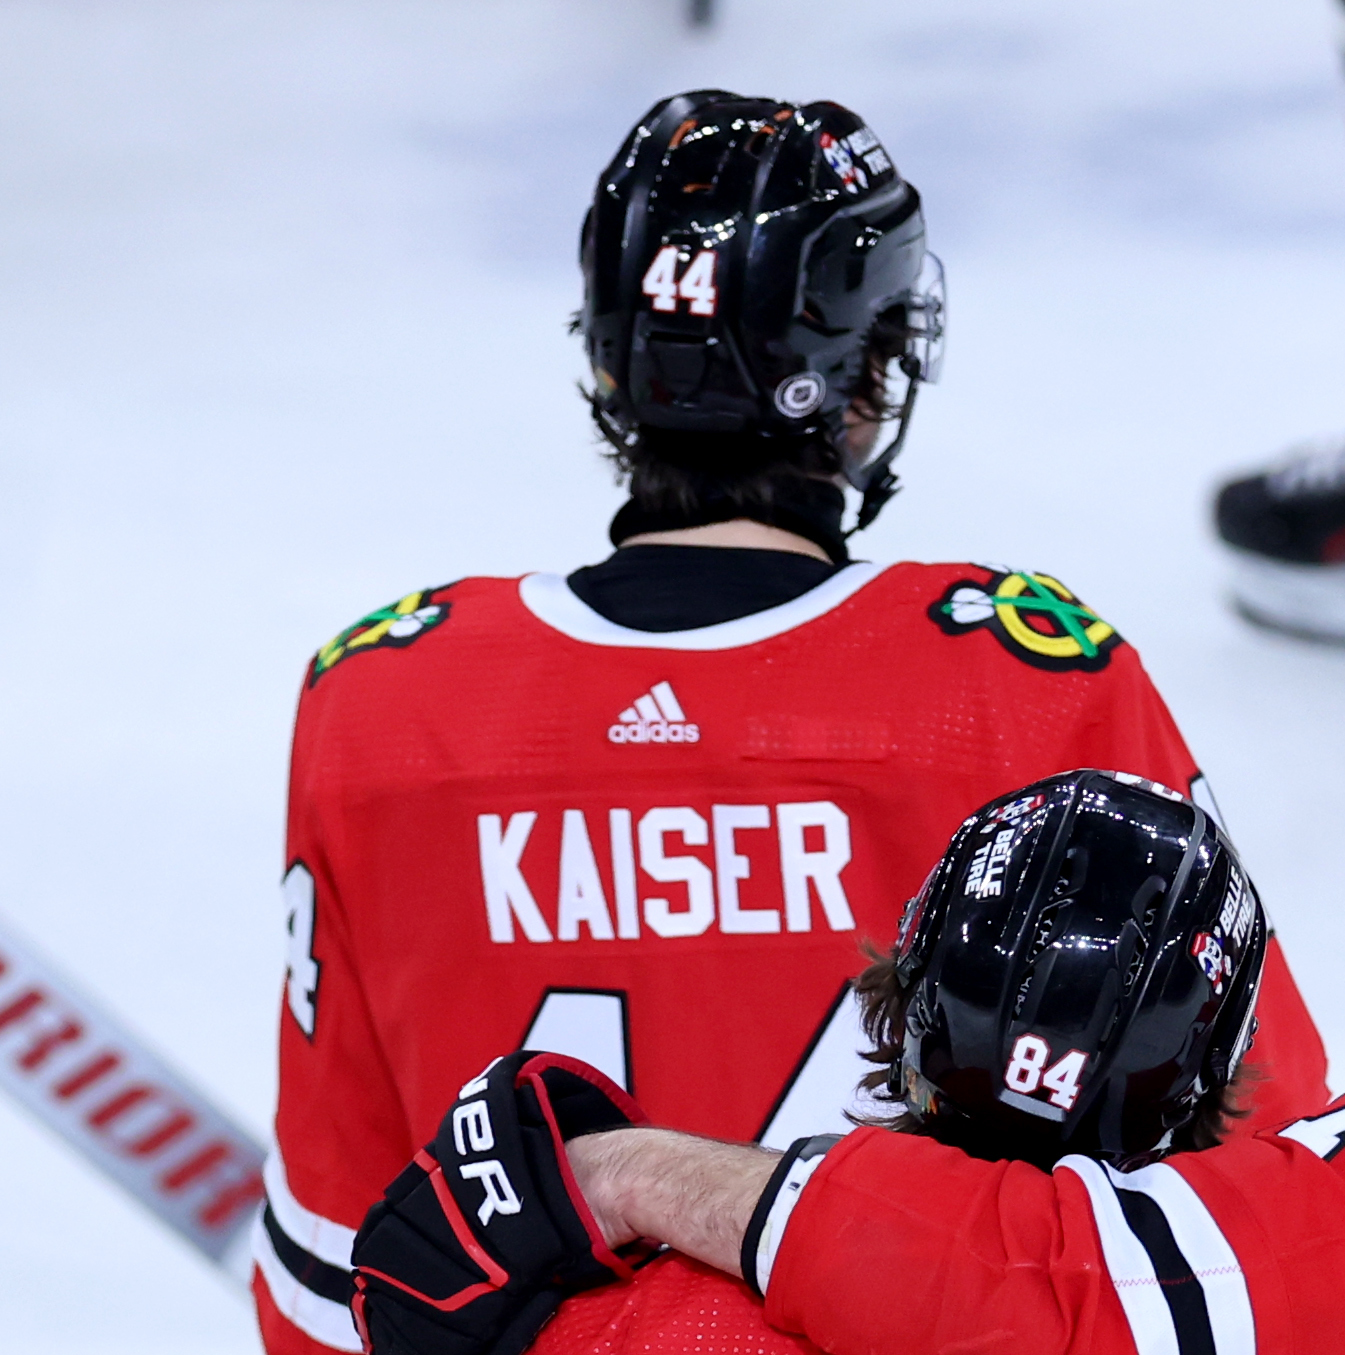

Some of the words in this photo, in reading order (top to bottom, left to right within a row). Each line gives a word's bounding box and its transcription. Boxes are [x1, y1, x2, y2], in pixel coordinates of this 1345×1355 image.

[643, 245, 719, 318] 44
[607, 718, 701, 744] adidas
[477, 801, 856, 943] KAISER
[964, 841, 993, 896] TIRE
[982, 828, 1015, 898] BELLE
[1219, 865, 1243, 938] BELLE
[1231, 892, 1252, 948] TIRE
[0, 955, 264, 1234] RIOR
[1005, 1034, 1089, 1112] 84
